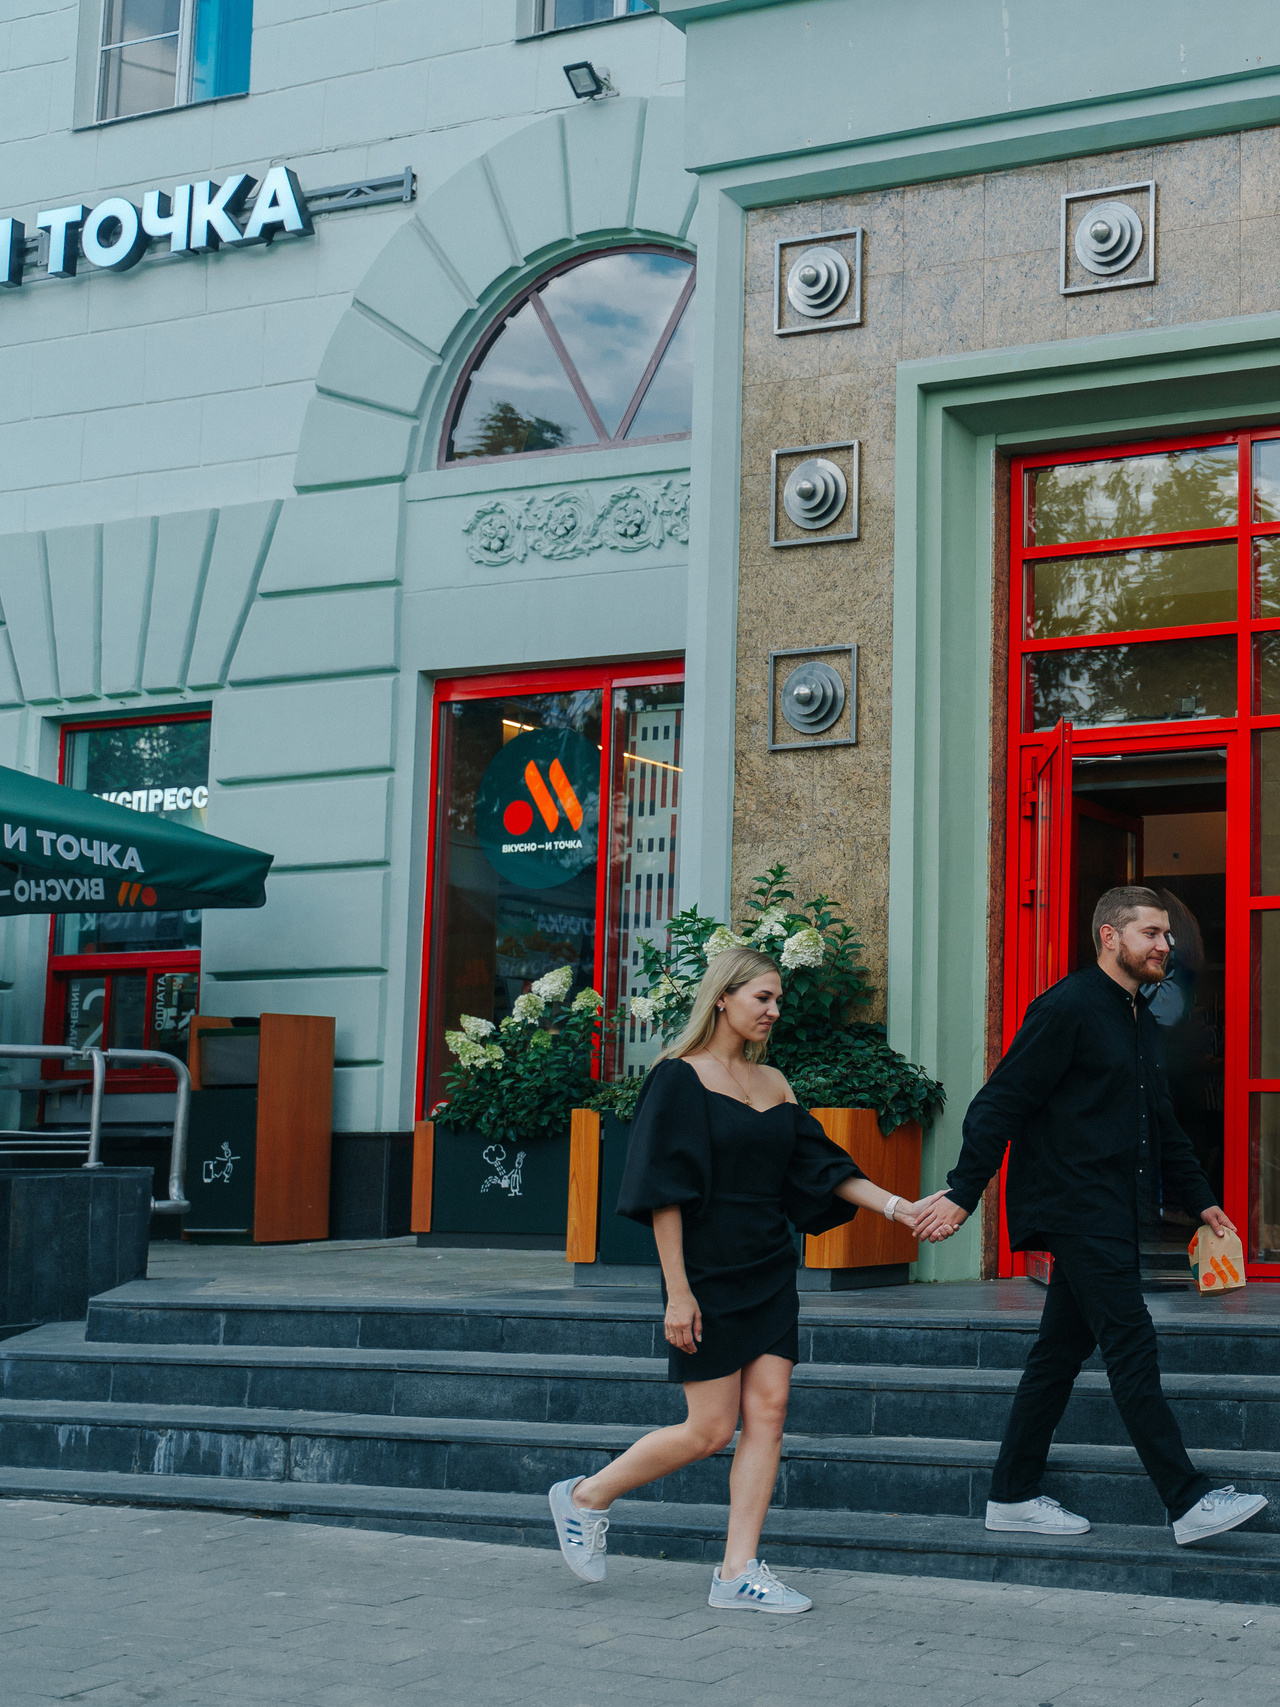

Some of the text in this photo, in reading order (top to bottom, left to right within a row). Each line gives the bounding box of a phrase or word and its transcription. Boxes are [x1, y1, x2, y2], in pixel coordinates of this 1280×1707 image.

[37, 165, 306, 276] ТОЧКА
[92, 785, 209, 813] СПРЕСС
[4, 823, 145, 873] И ТОЧКА
[502, 842, 537, 854] ВКУСНО
[553, 839, 583, 850] ТОЧКА
[69, 983, 81, 1066] ПЛУЧЕНИЕ
[154, 976, 167, 1031] ОПЛАТА
